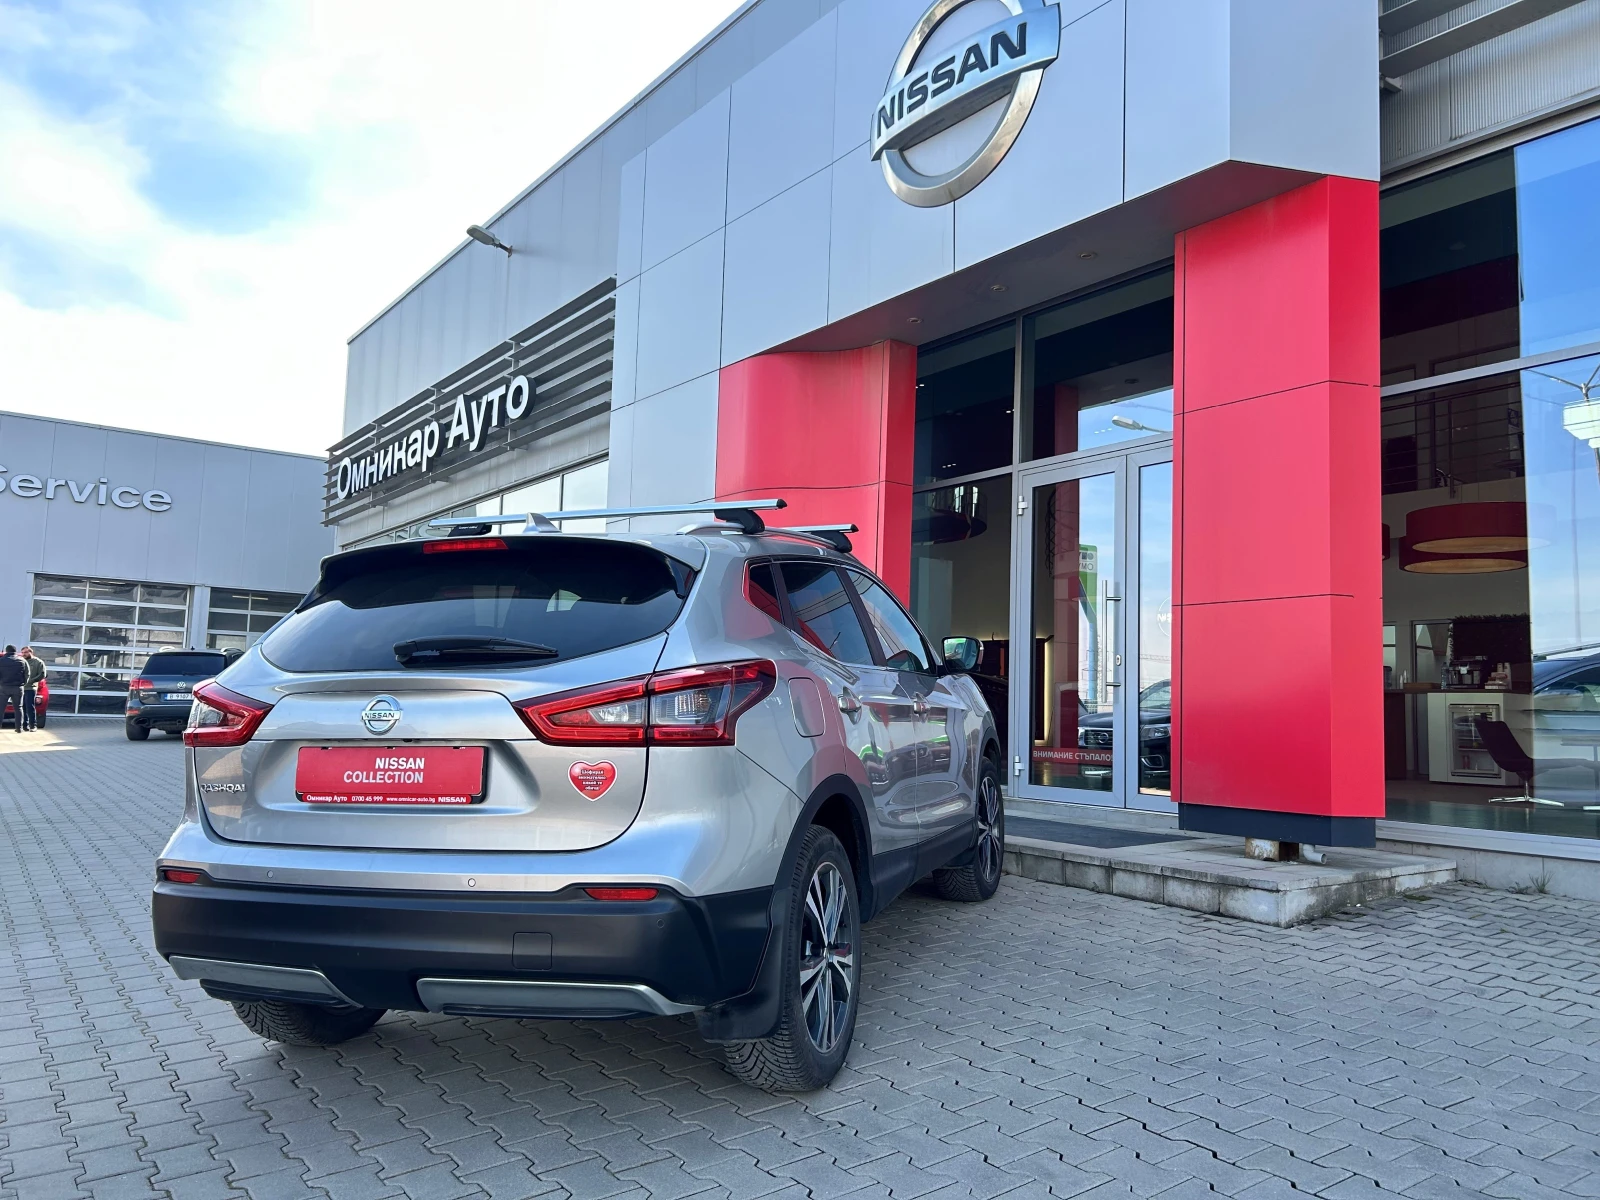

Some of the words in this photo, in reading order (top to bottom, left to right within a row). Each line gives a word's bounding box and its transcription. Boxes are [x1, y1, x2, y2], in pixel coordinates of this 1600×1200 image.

[876, 21, 1028, 140] NISSAN
[337, 421, 442, 500] Омникар
[447, 375, 531, 452] Ауто
[0, 464, 172, 512] ervice
[1033, 750, 1073, 760] ВНИМАНИЕ
[375, 757, 425, 770] NISSAN
[343, 770, 424, 783] COLLECTION
[200, 783, 246, 793] QASHQAI
